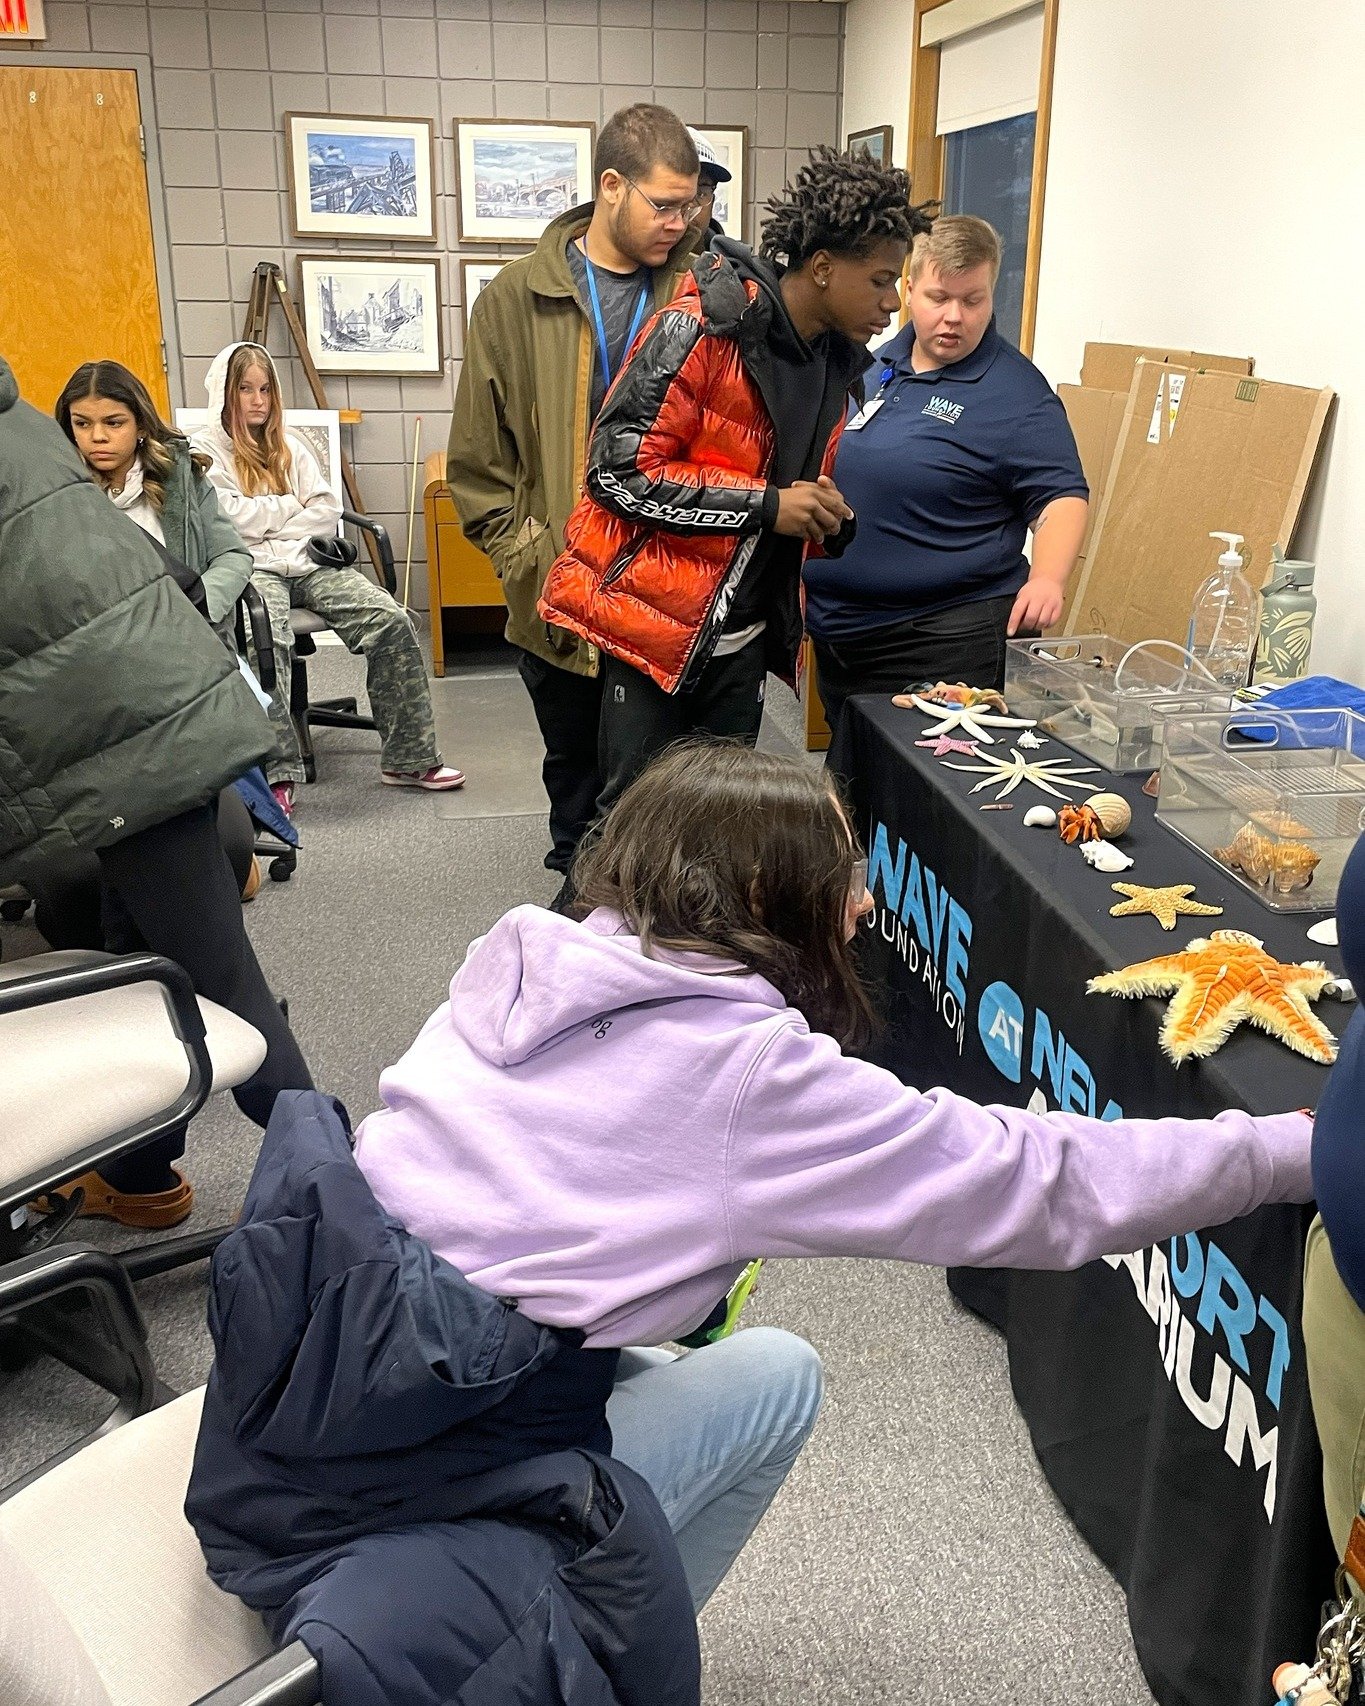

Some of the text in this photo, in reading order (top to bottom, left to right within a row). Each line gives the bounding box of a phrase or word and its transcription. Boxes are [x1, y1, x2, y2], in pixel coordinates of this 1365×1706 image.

[928, 395, 965, 415] WAVE
[866, 907, 965, 1056] OUNDATION
[988, 1007, 1023, 1058] AT
